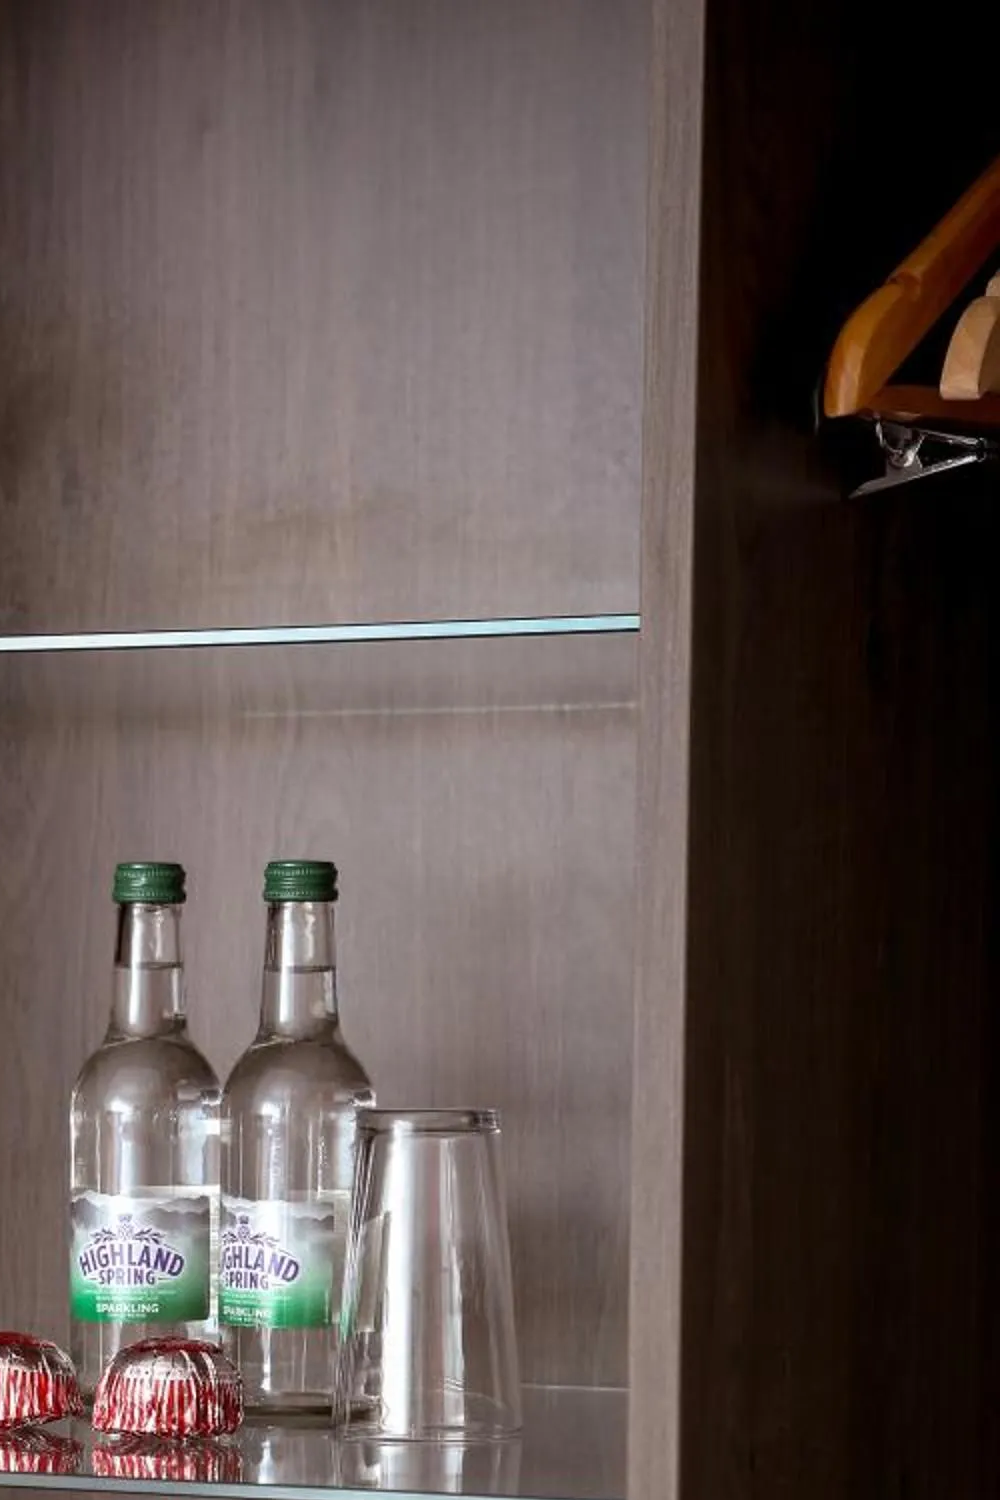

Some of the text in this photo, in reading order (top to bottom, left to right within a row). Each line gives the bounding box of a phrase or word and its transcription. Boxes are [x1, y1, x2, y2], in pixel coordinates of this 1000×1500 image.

[79, 1243, 185, 1277] HIGHLAND
[219, 1245, 299, 1283] GHLAND
[98, 1268, 155, 1286] SPRING
[95, 1303, 160, 1313] SPARKLING
